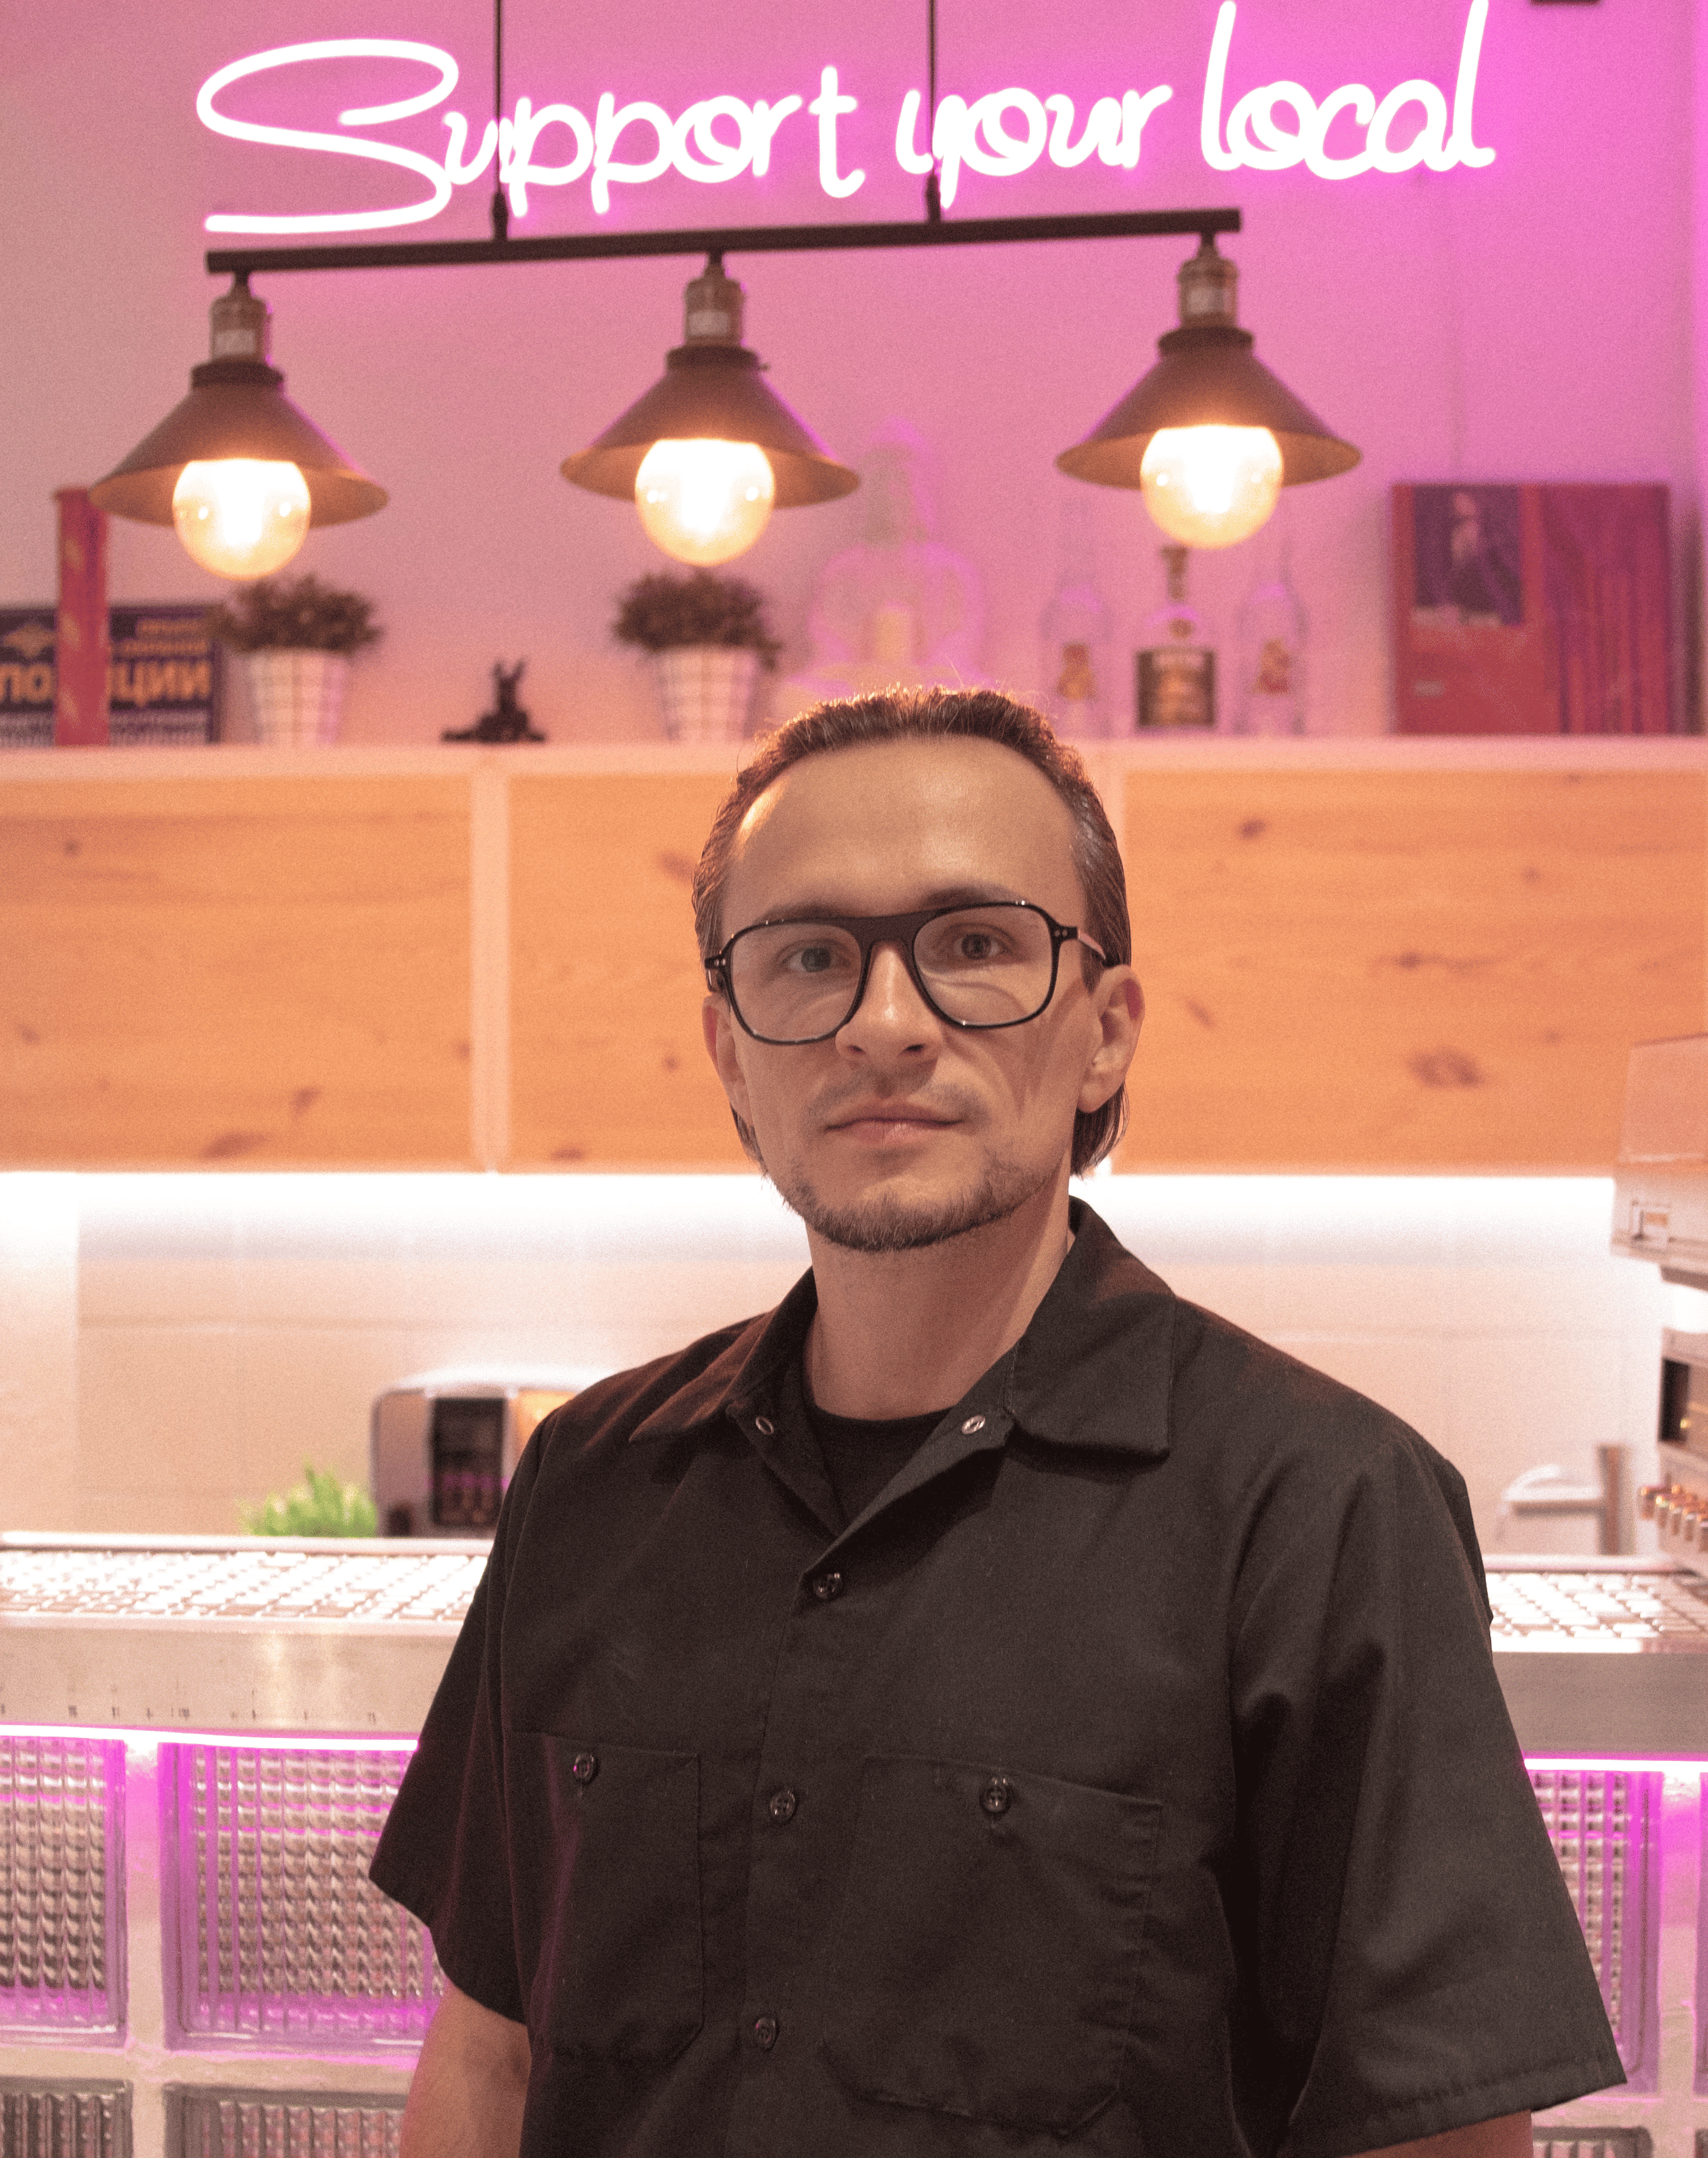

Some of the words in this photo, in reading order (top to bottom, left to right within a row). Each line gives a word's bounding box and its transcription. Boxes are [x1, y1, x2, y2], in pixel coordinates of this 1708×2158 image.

[195, 38, 866, 234] Support
[895, 84, 1174, 210] your
[1200, 0, 1497, 181] local
